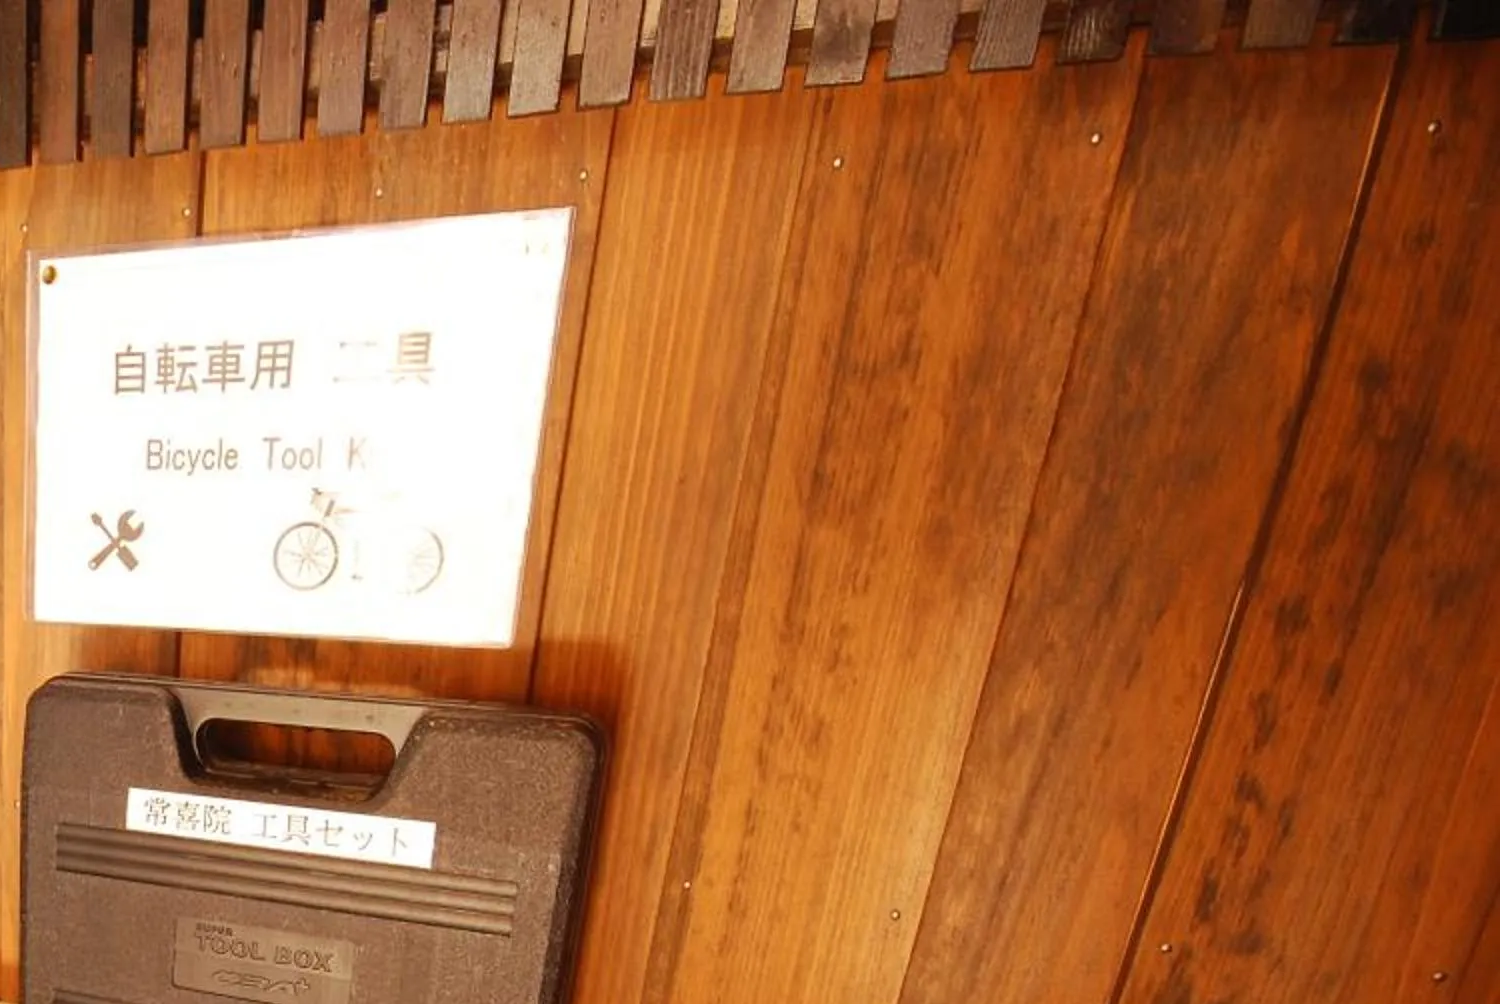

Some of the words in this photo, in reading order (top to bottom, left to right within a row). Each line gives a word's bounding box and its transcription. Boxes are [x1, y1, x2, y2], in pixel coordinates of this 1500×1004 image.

[112, 337, 295, 395] 自転車用
[145, 437, 240, 476] Bicycle
[262, 436, 324, 472] Tool
[251, 812, 409, 858] 工具セット
[195, 934, 266, 962] TOOL
[273, 945, 334, 973] BOX
